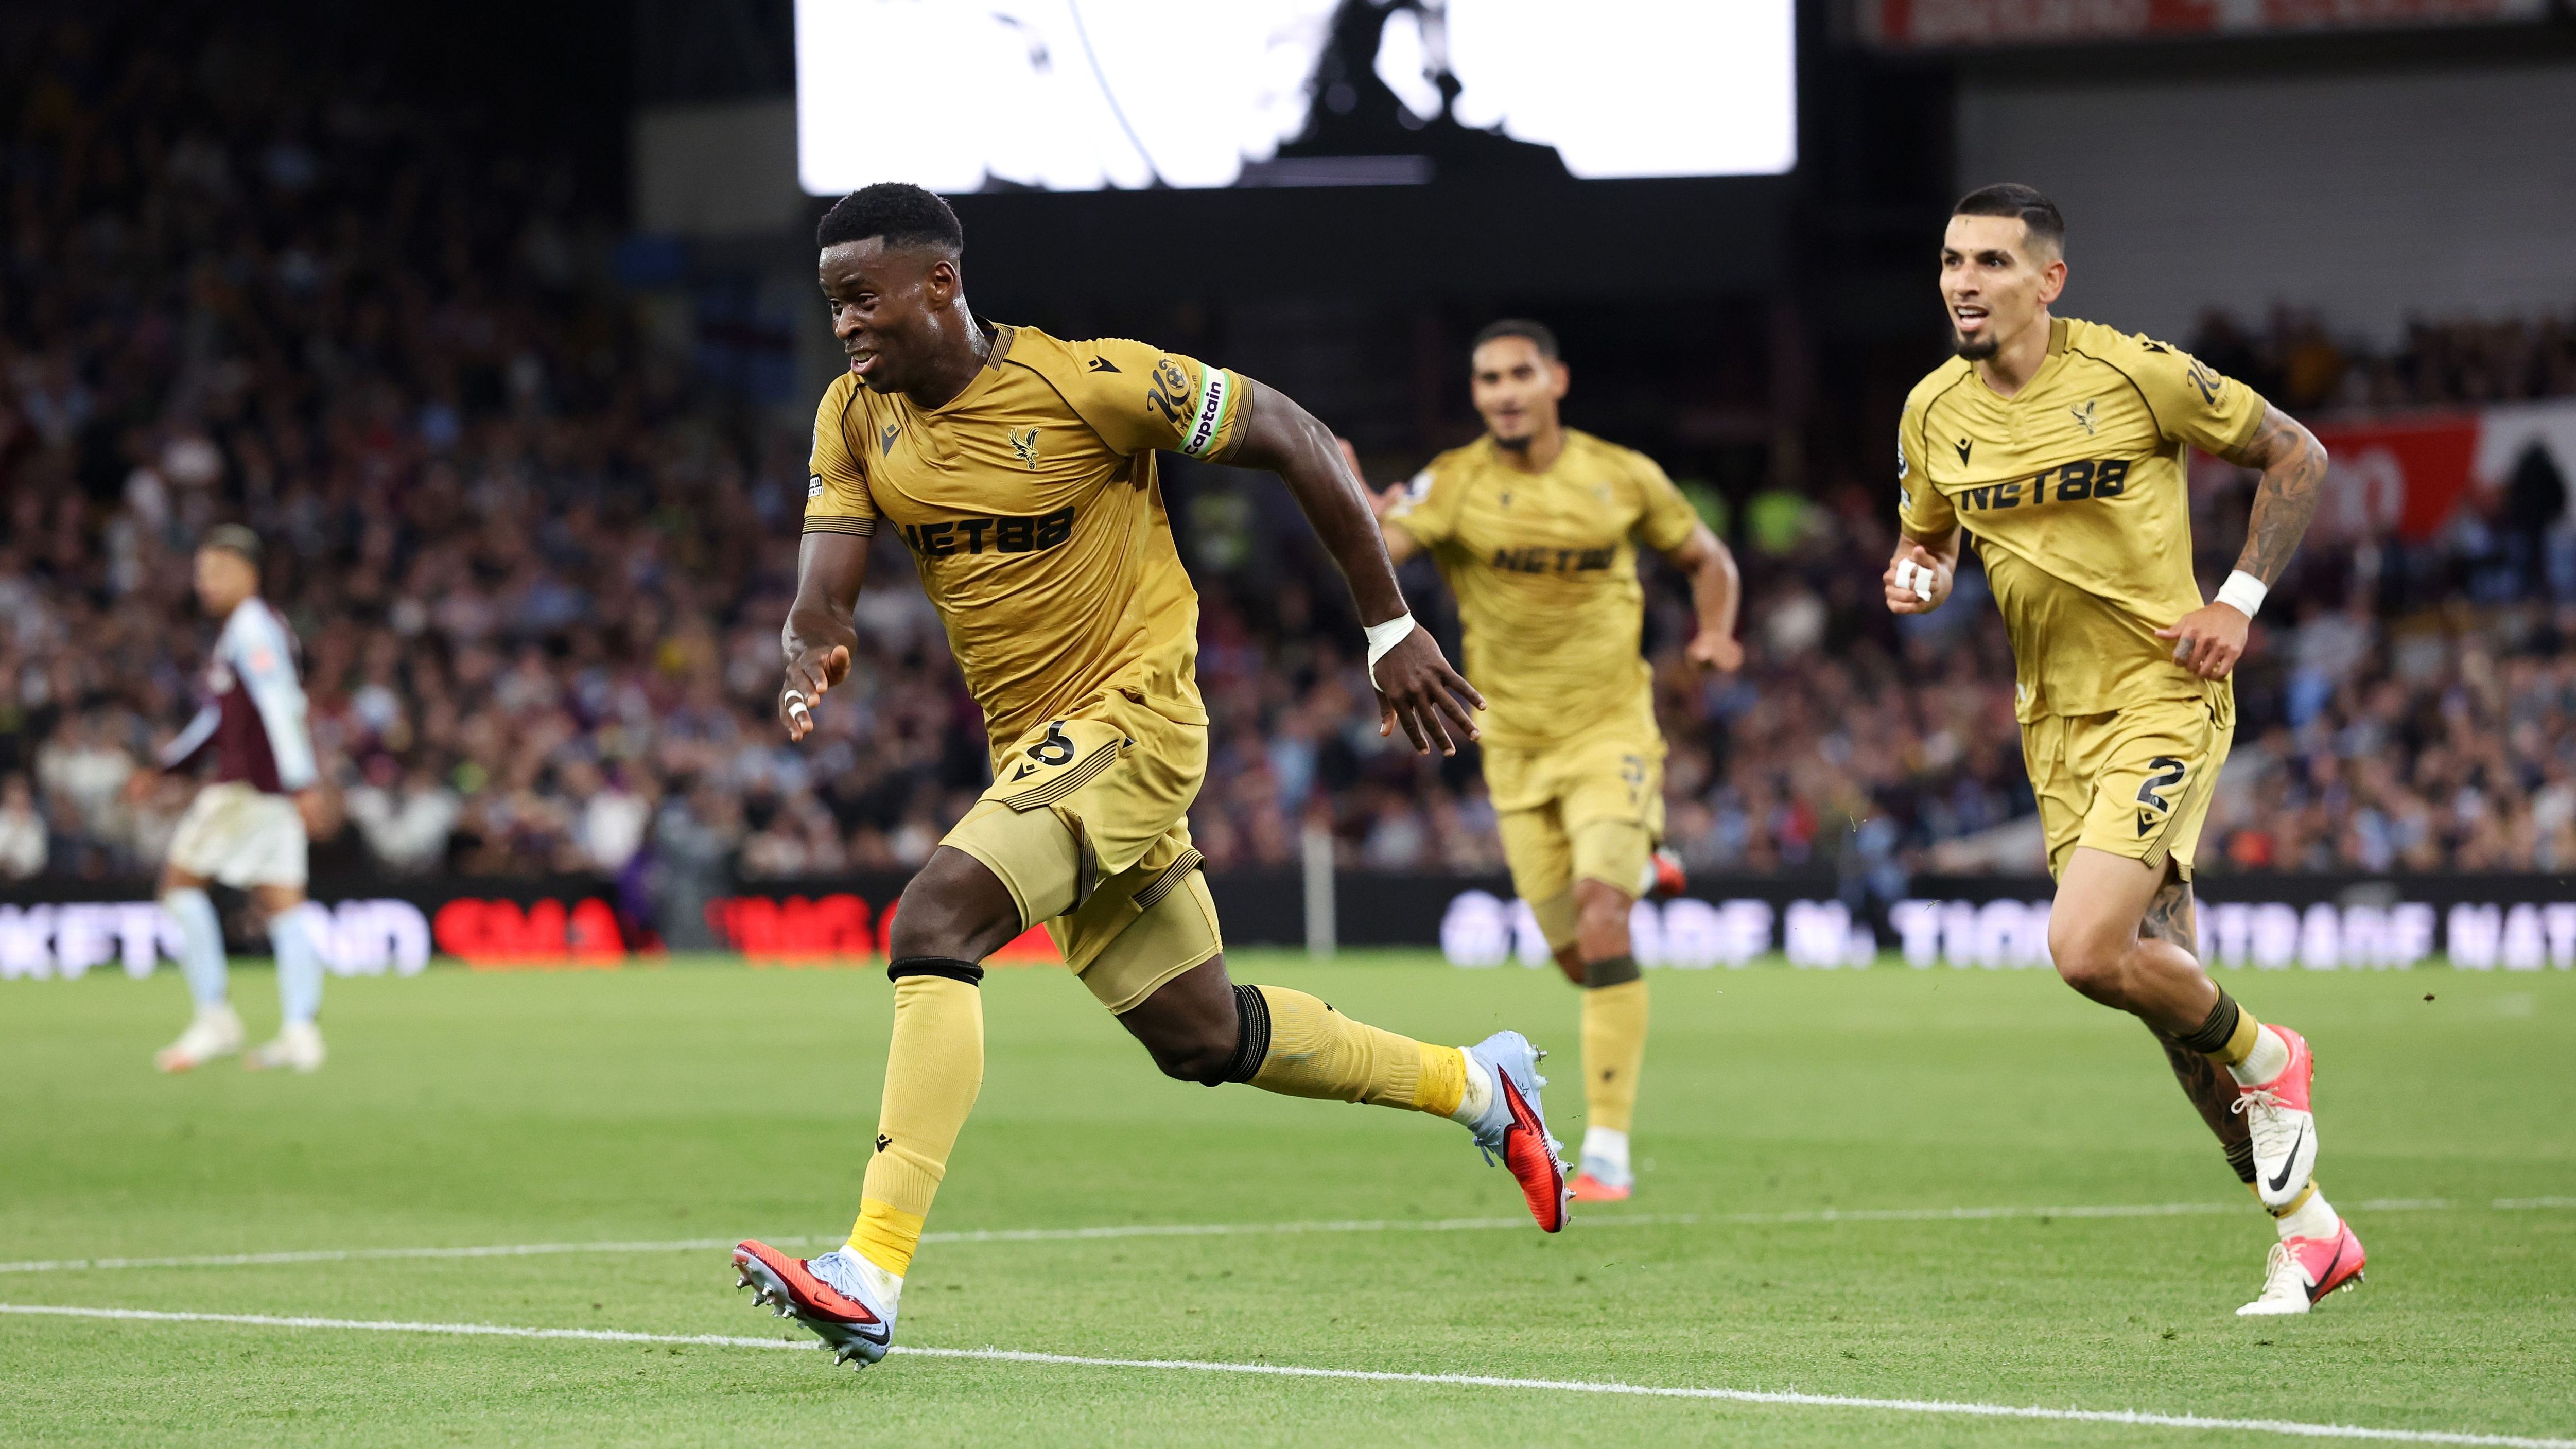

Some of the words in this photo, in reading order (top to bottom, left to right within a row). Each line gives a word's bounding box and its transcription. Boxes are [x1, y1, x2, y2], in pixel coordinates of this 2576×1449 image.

[1184, 381, 1222, 455] Captain
[1026, 720, 1075, 766] 6
[2136, 756, 2186, 815] 2
